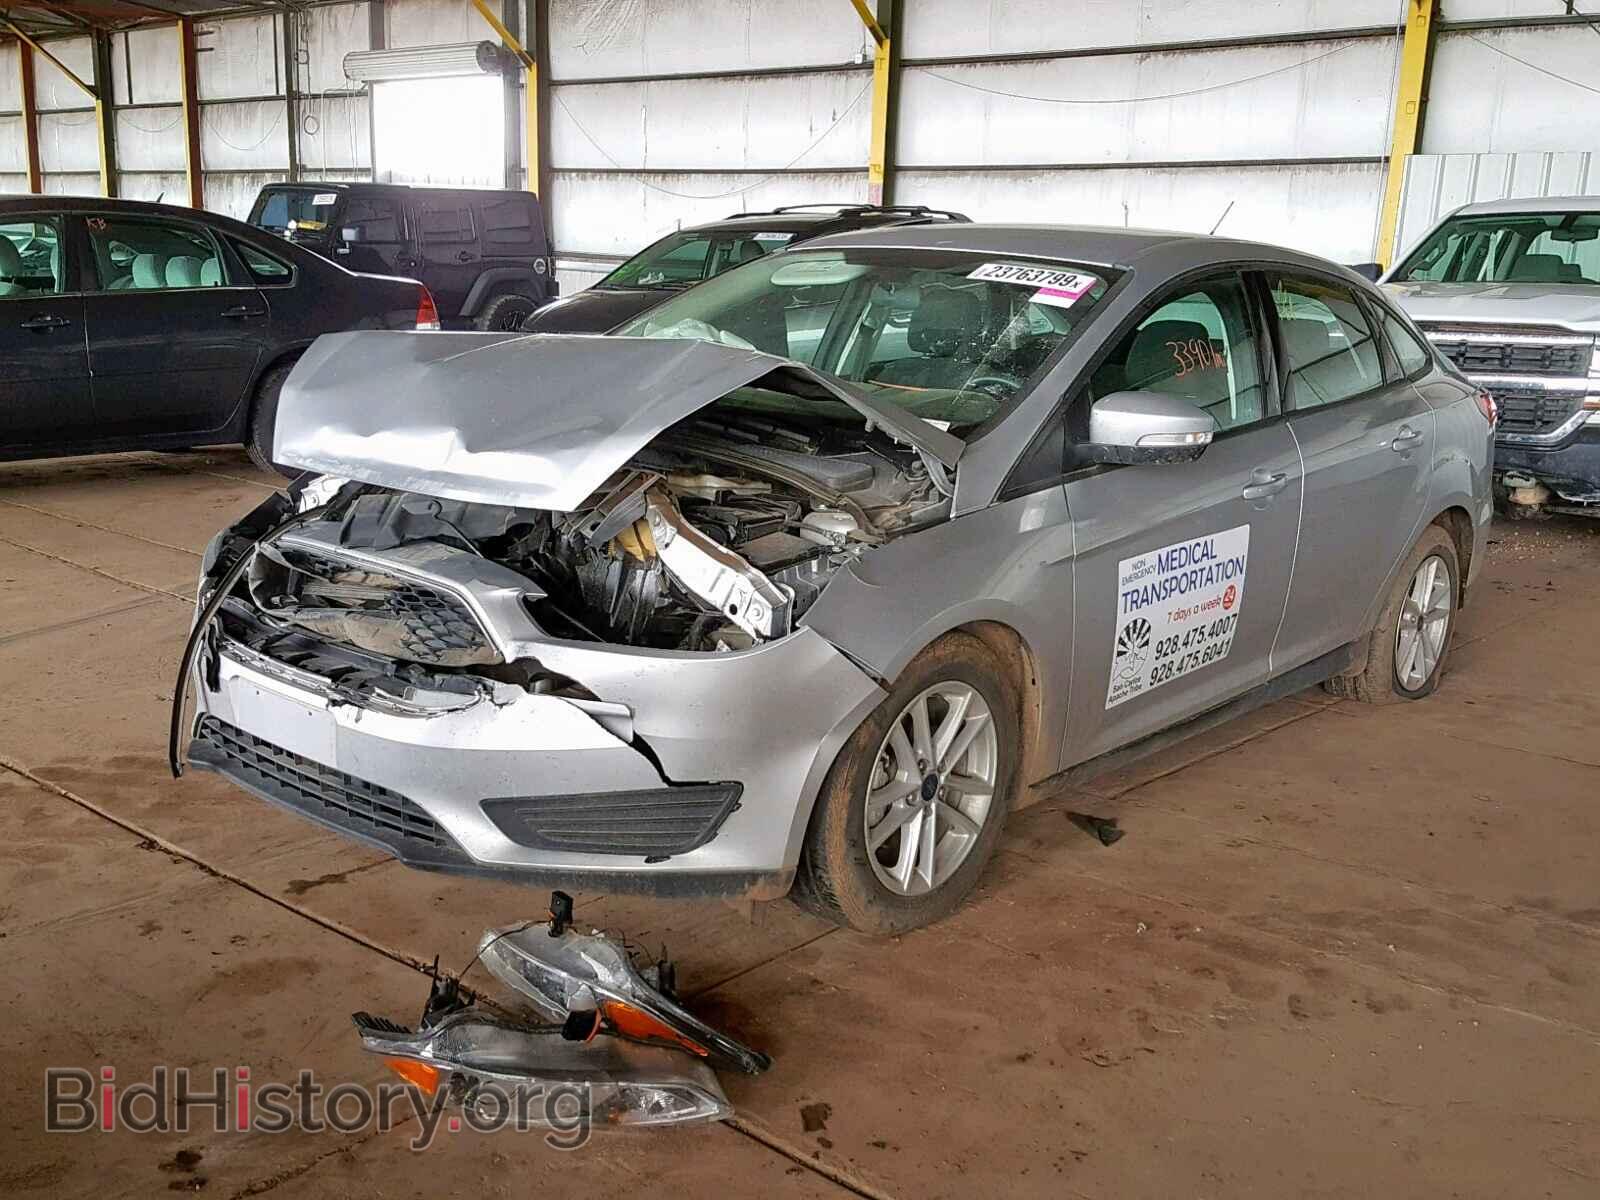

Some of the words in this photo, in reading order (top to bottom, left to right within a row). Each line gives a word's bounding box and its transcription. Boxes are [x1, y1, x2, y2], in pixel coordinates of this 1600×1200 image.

[1132, 558, 1146, 571] NON
[1157, 538, 1217, 575] MEDICAL
[1122, 555, 1245, 614] TRANSPORTATION
[1167, 611, 1173, 624] 7
[1173, 606, 1192, 623] days
[1193, 605, 1199, 615] a
[1200, 595, 1221, 612] week
[1154, 613, 1238, 661] 928.475.4007
[1149, 638, 1231, 687] 928.475.6041
